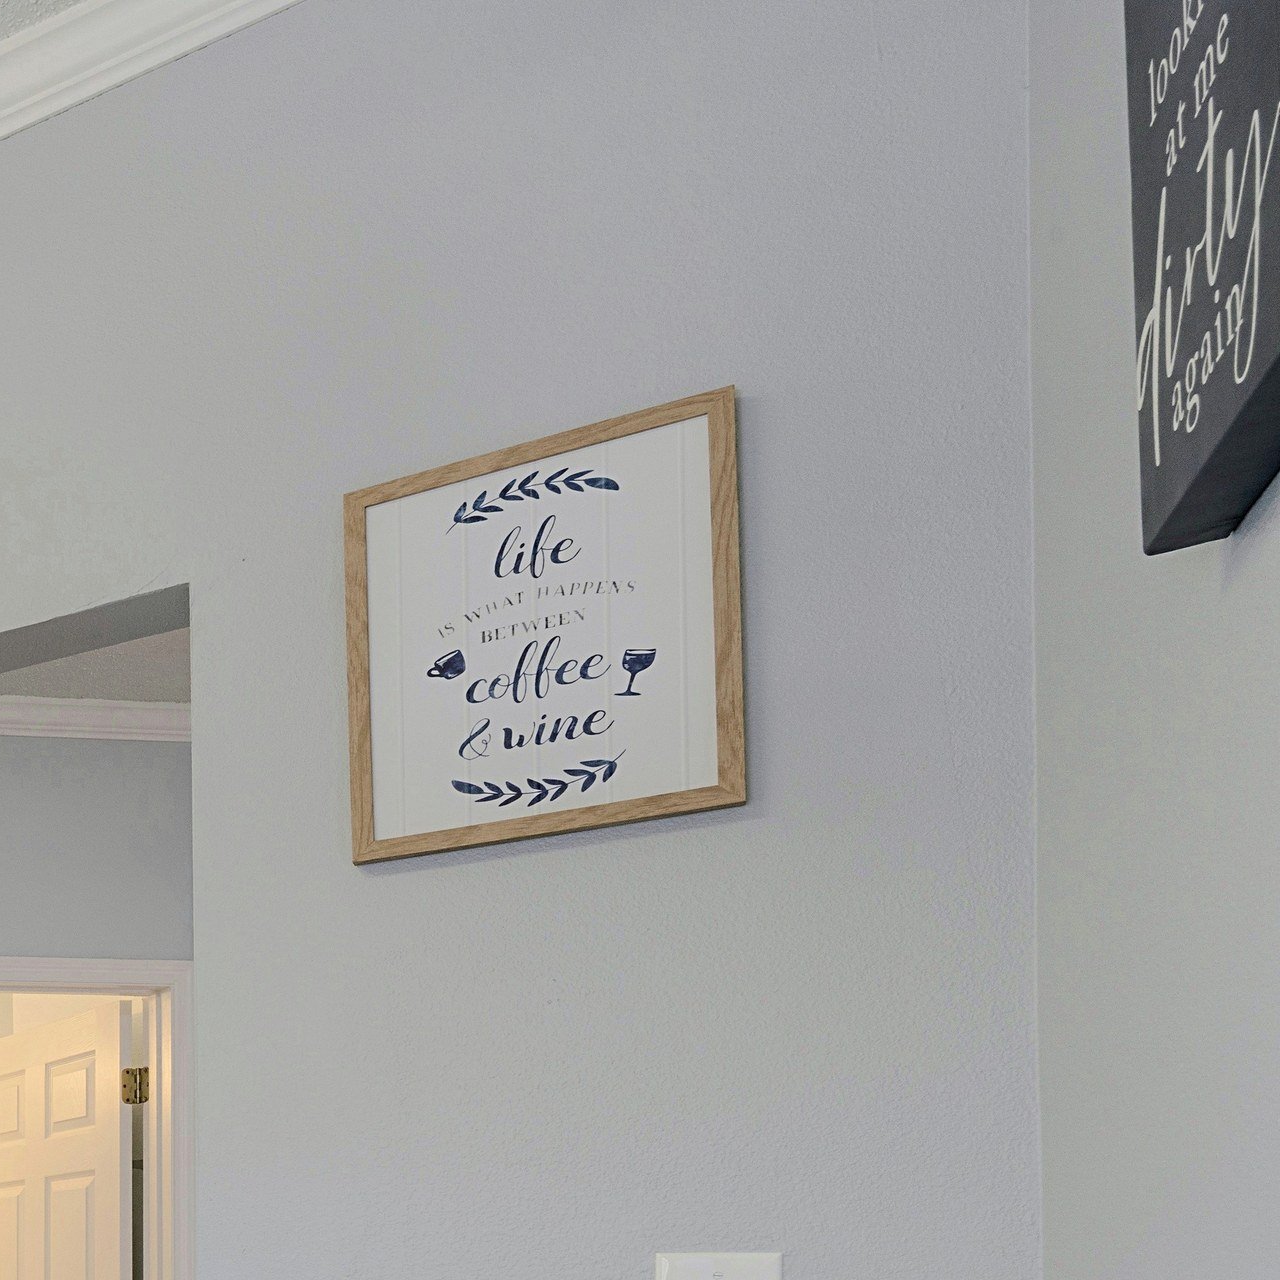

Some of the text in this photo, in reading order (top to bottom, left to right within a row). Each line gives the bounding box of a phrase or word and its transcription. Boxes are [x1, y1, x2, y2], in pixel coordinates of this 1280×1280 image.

[1165, 13, 1229, 177] at me
[1137, 96, 1280, 466] dirty
[1172, 284, 1243, 434] again
[494, 515, 582, 579] life
[437, 579, 638, 639] IS WHAT HAPPENS
[481, 607, 587, 644] BETWEEN
[465, 635, 611, 704] coffee
[458, 708, 615, 761] & wine
